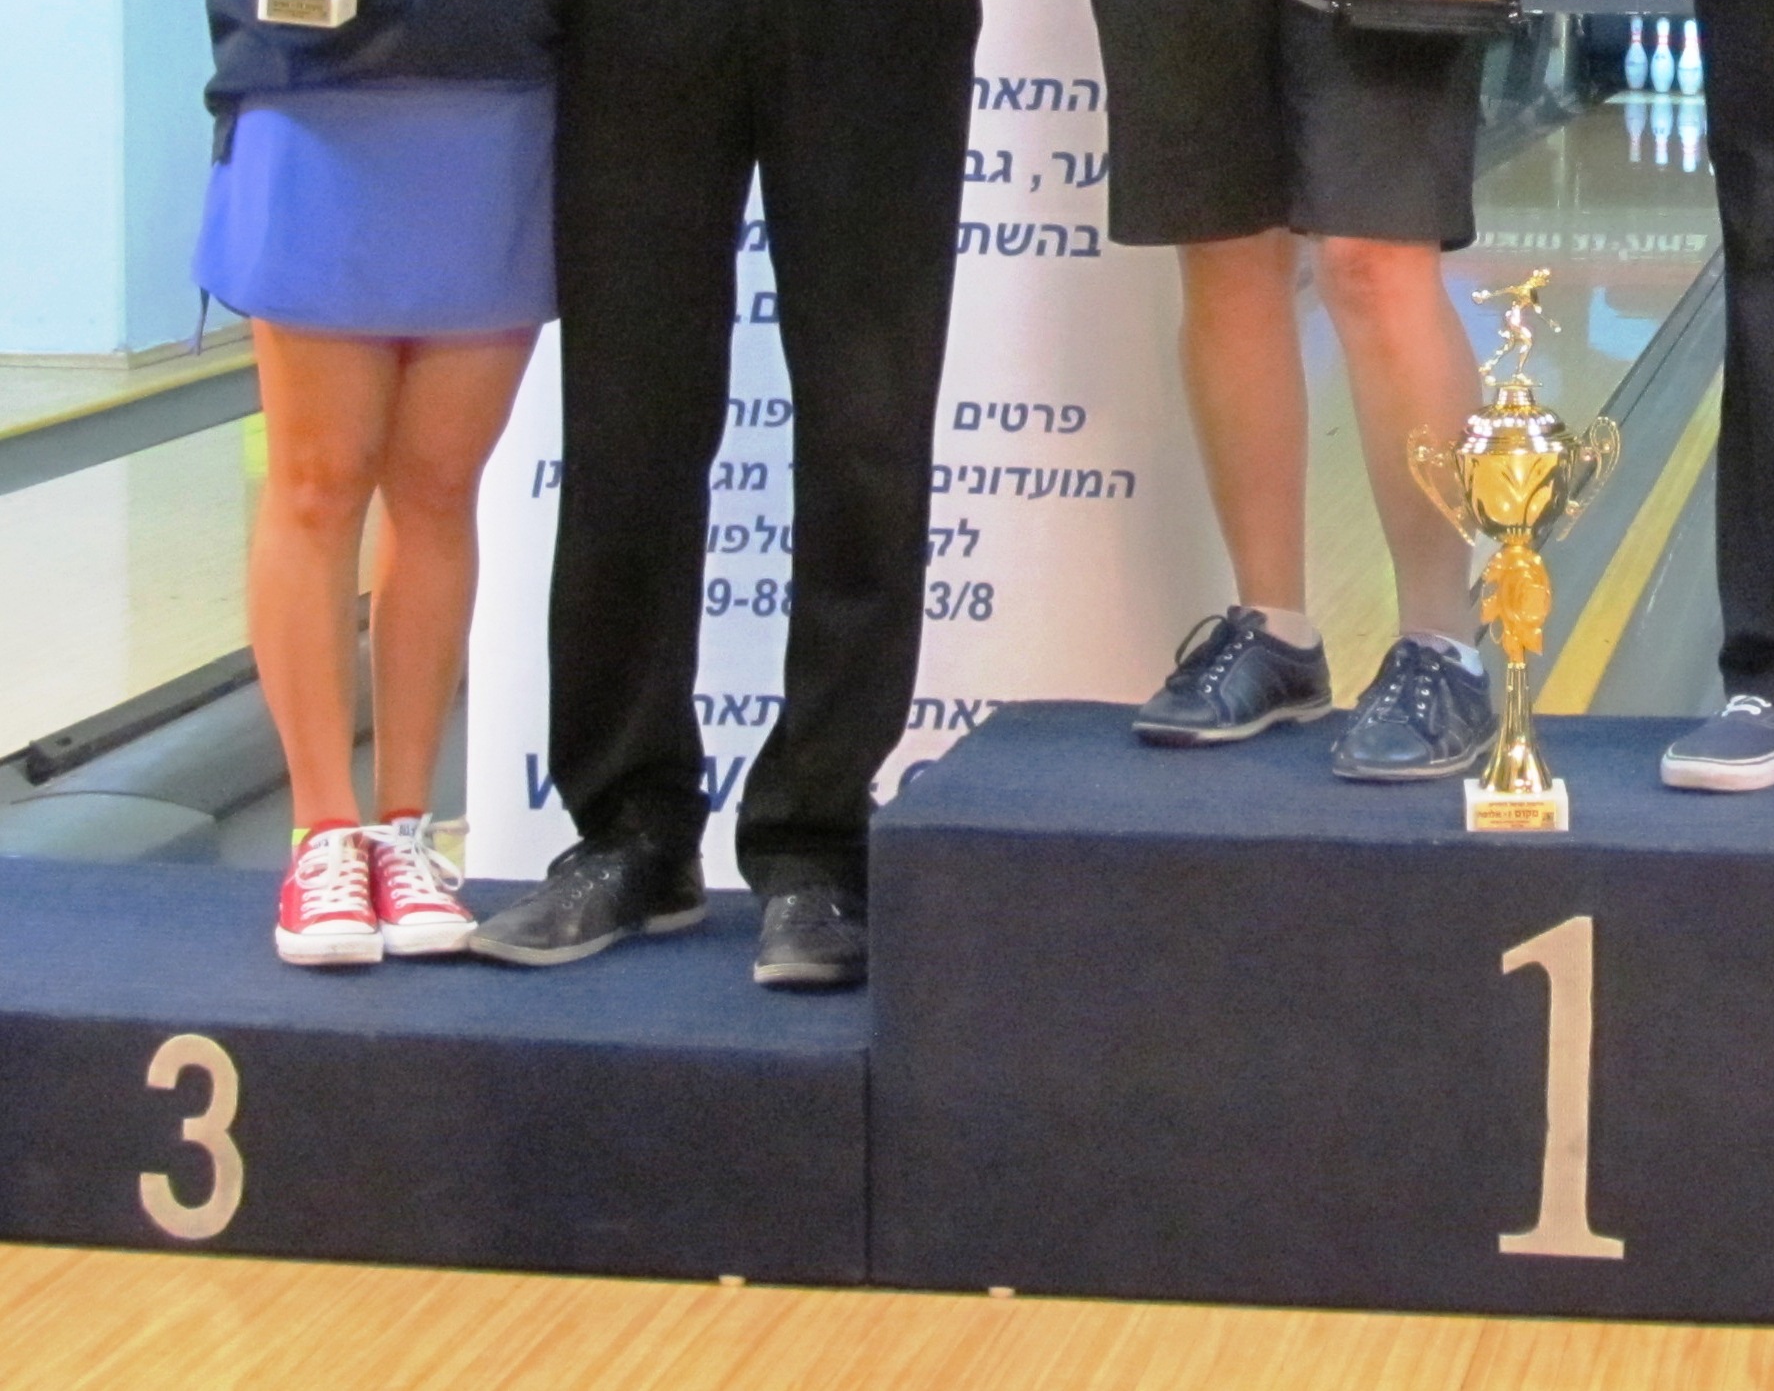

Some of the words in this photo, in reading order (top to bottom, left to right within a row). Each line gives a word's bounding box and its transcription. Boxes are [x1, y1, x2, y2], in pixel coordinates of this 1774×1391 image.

[957, 222, 1101, 257] בהשת
[953, 401, 1086, 434] פרטים
[931, 465, 1136, 500] המועדונים
[1499, 916, 1625, 1260] 1
[139, 1032, 245, 1241] 3
